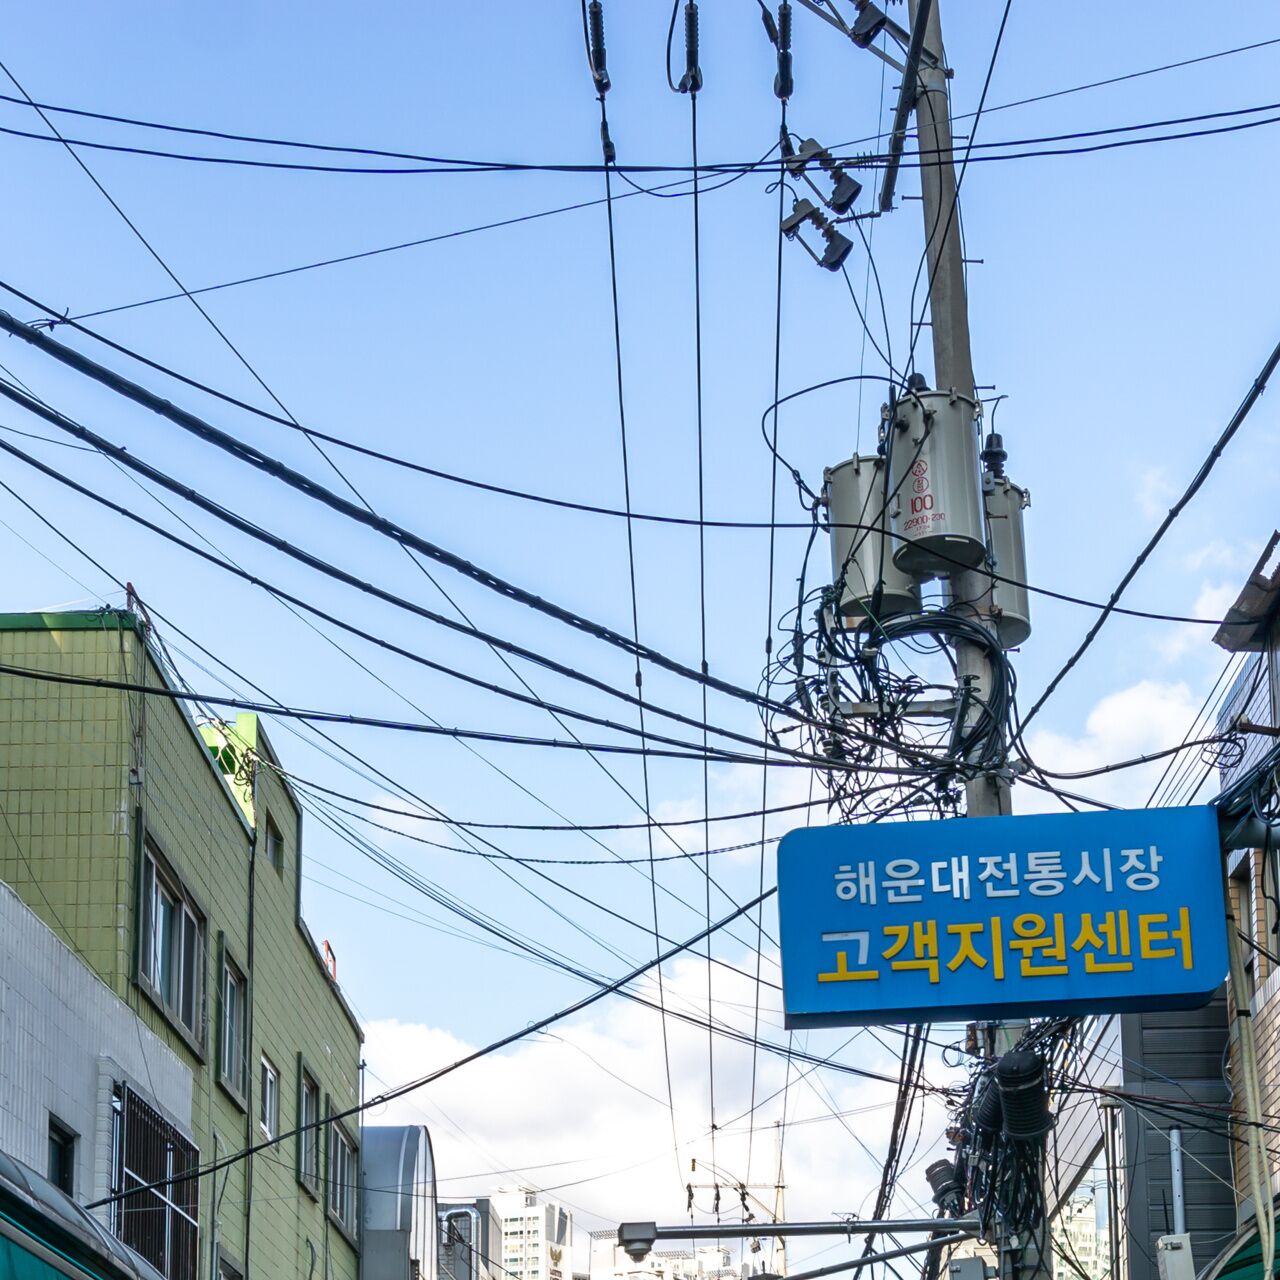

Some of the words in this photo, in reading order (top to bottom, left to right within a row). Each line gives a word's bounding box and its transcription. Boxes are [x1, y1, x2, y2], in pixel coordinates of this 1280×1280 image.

[910, 494, 934, 514] 100
[833, 845, 1163, 905] 해운대전통시장
[817, 907, 1194, 984] 고객지원센터
